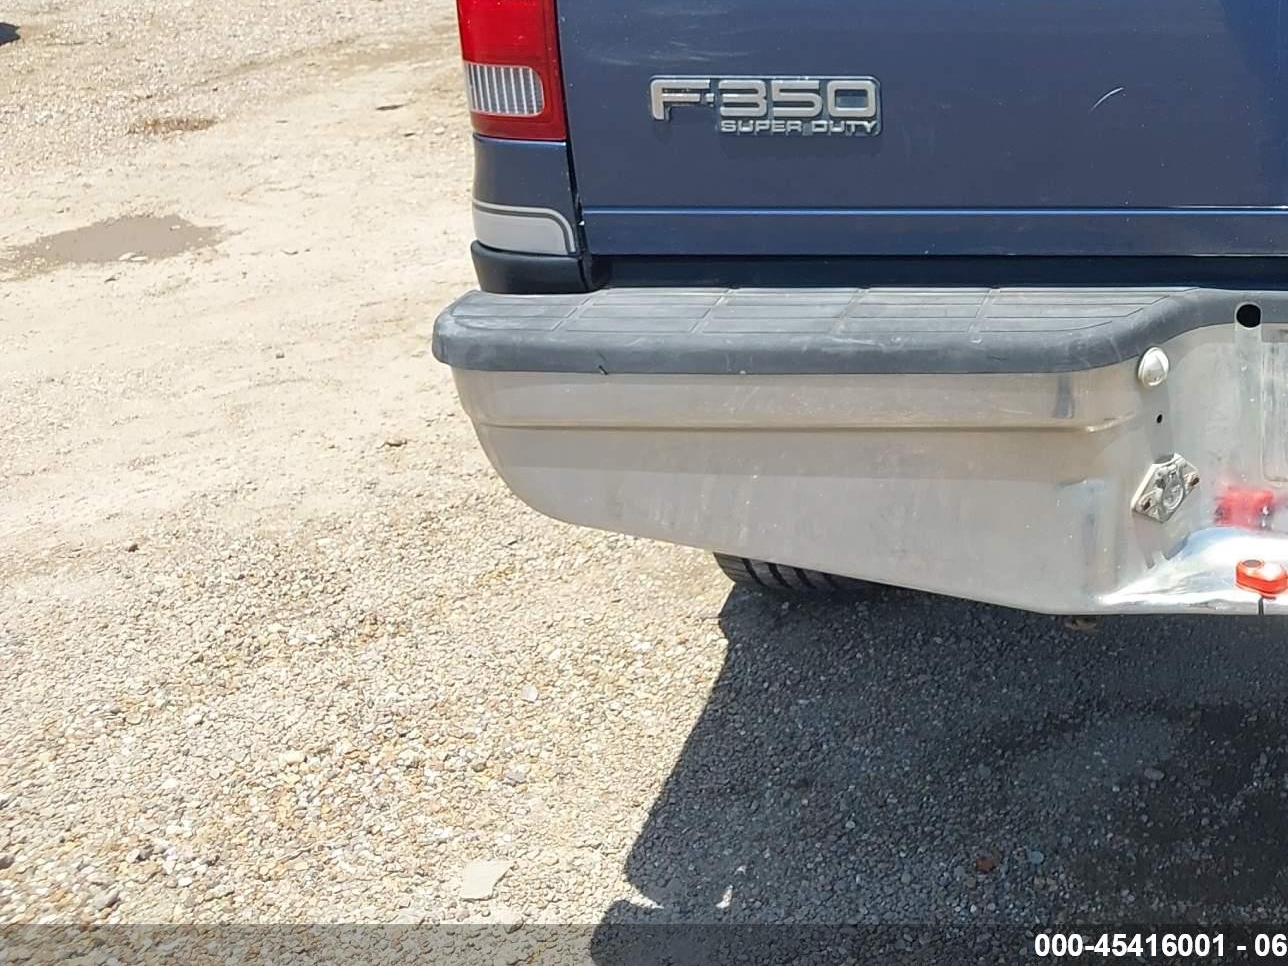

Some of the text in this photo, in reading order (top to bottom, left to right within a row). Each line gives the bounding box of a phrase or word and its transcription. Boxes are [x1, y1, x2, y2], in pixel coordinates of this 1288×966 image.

[650, 79, 878, 121] F-350
[720, 120, 878, 133] SUPER DUTY
